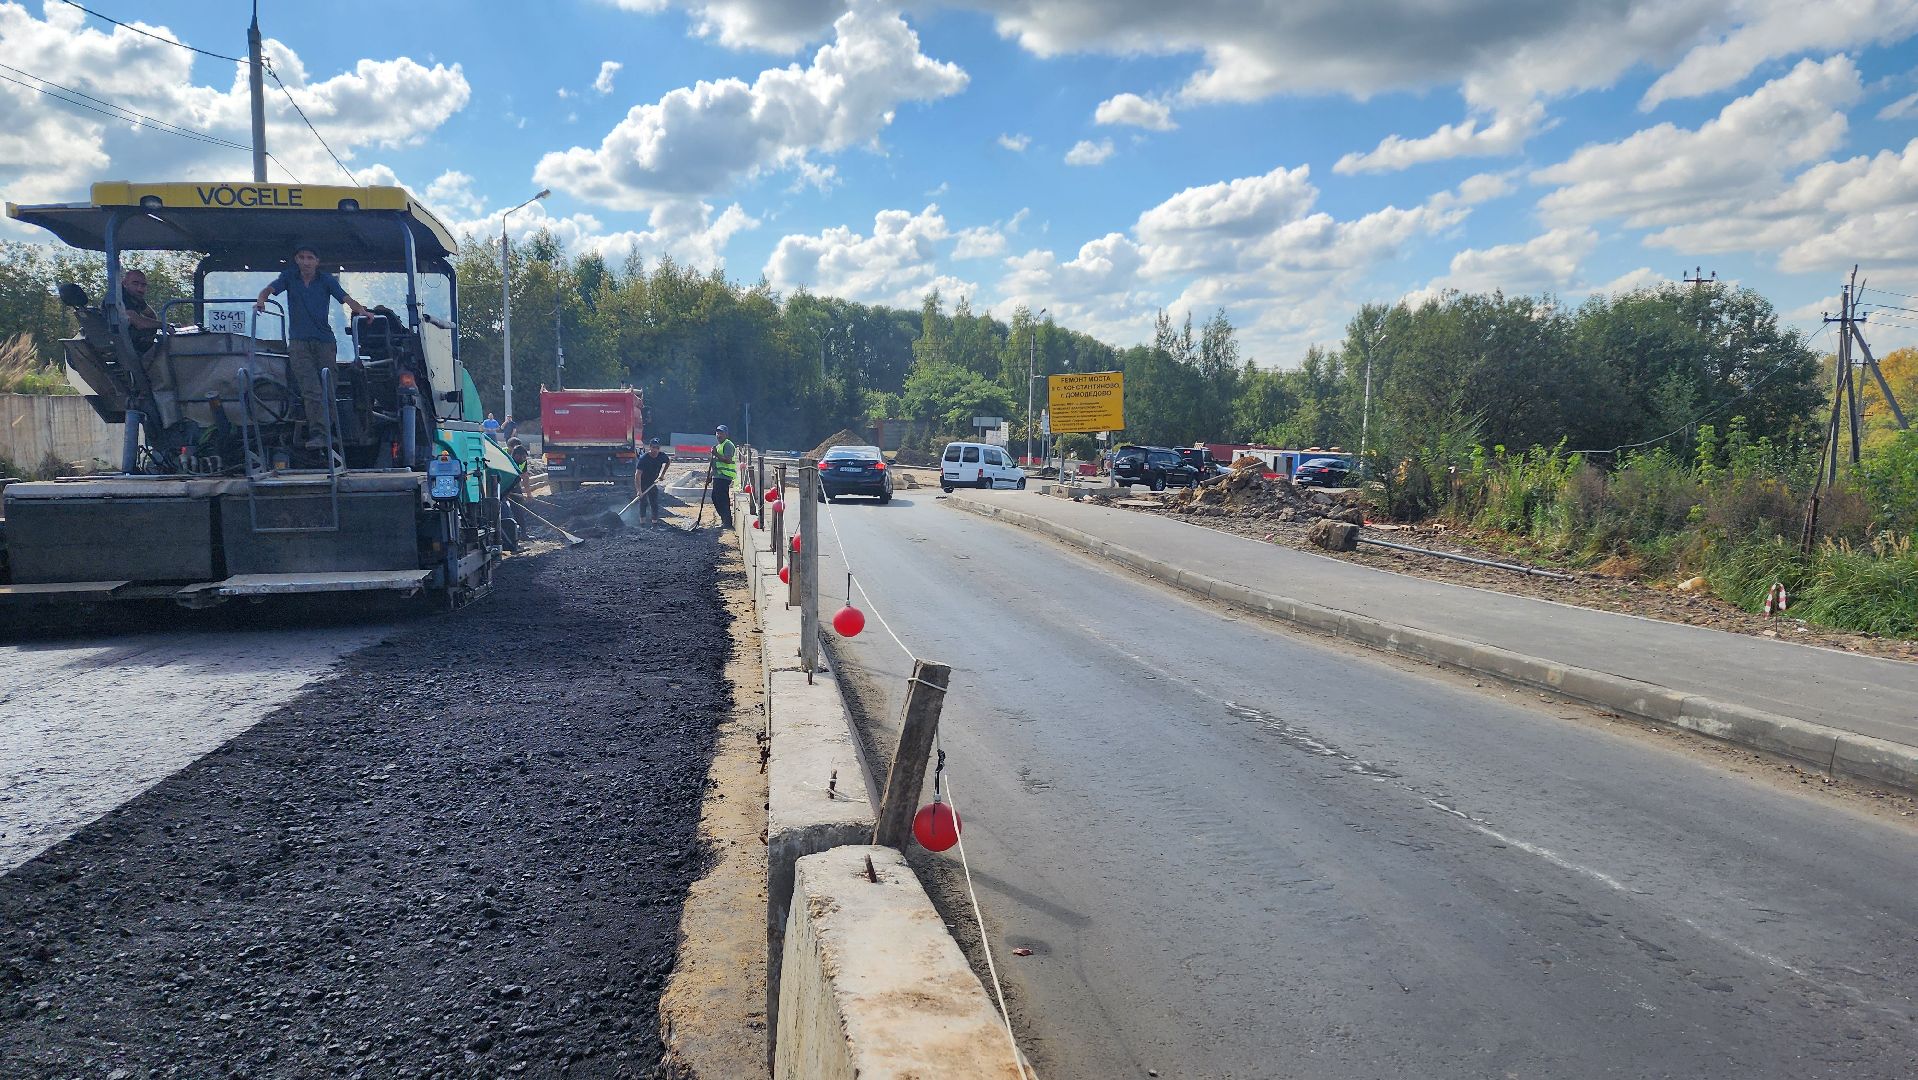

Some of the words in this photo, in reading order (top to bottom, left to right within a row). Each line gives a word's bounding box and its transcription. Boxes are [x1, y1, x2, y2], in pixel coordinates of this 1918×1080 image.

[196, 183, 303, 207] VÖGELE
[213, 311, 240, 321] 3641
[232, 322, 243, 330] 50
[1065, 390, 1111, 398] ДОМОДЕДОВО
